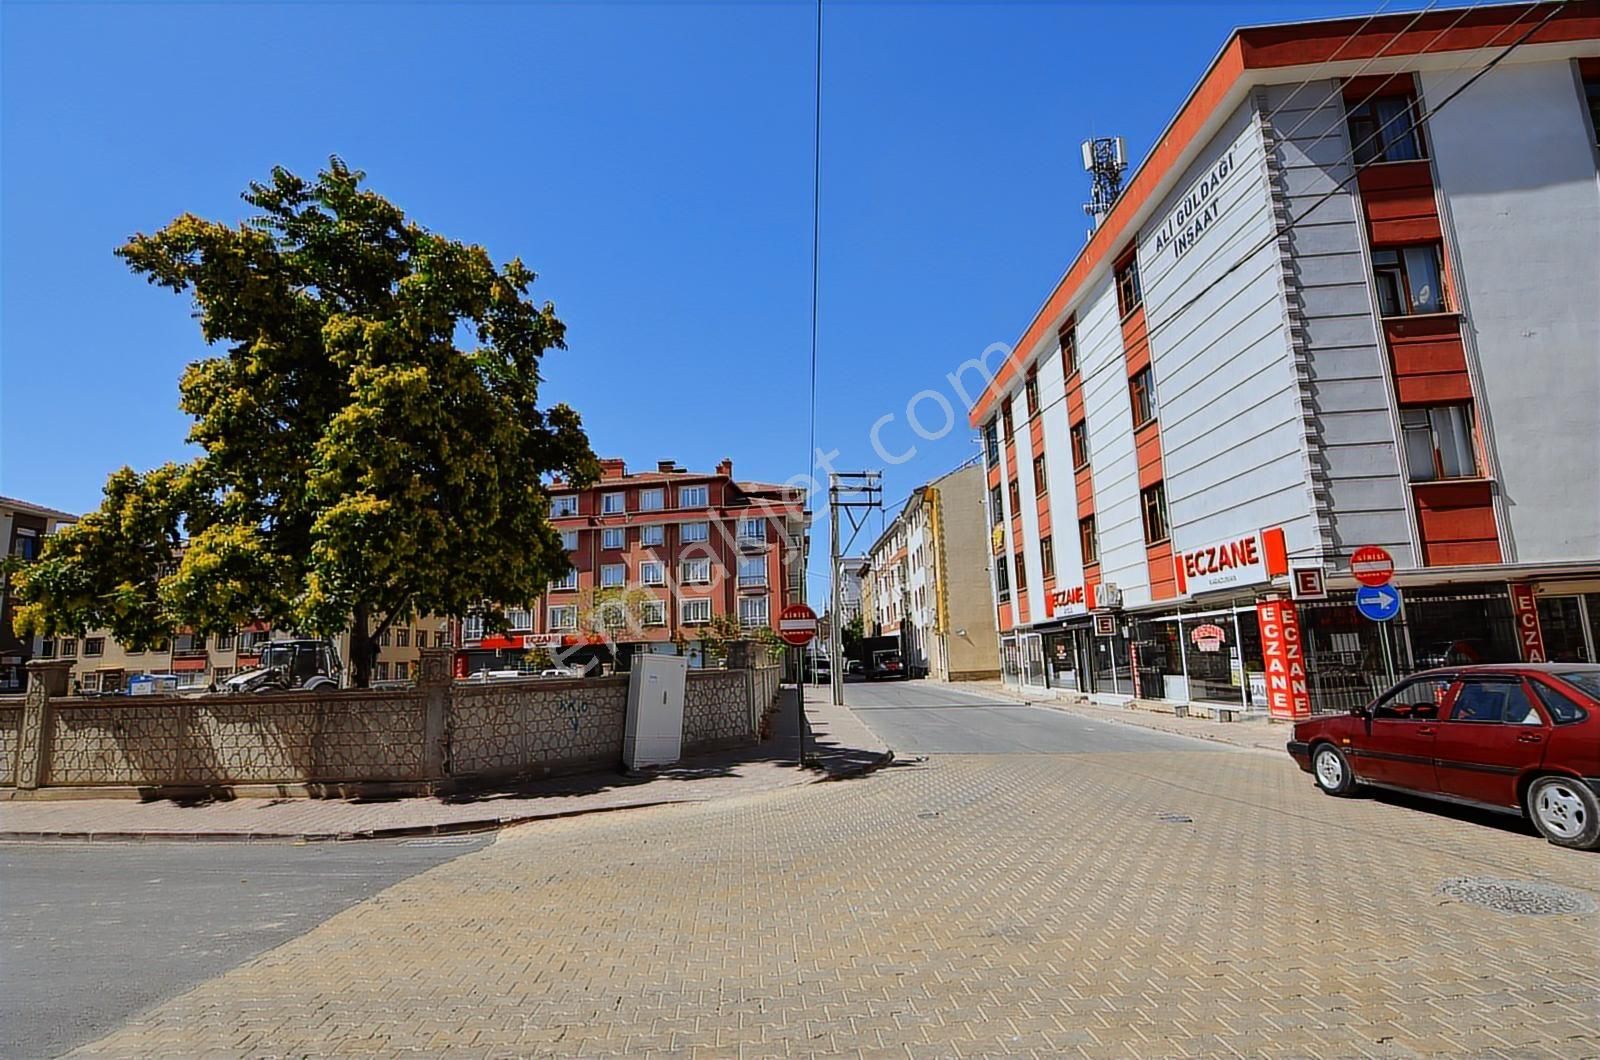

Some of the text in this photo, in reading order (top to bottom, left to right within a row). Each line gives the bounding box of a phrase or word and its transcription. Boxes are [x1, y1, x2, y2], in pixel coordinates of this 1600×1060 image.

[1185, 536, 1259, 578] ECZANE
[1262, 607, 1289, 708] ECZANE
[1282, 610, 1308, 712] ECZANE
